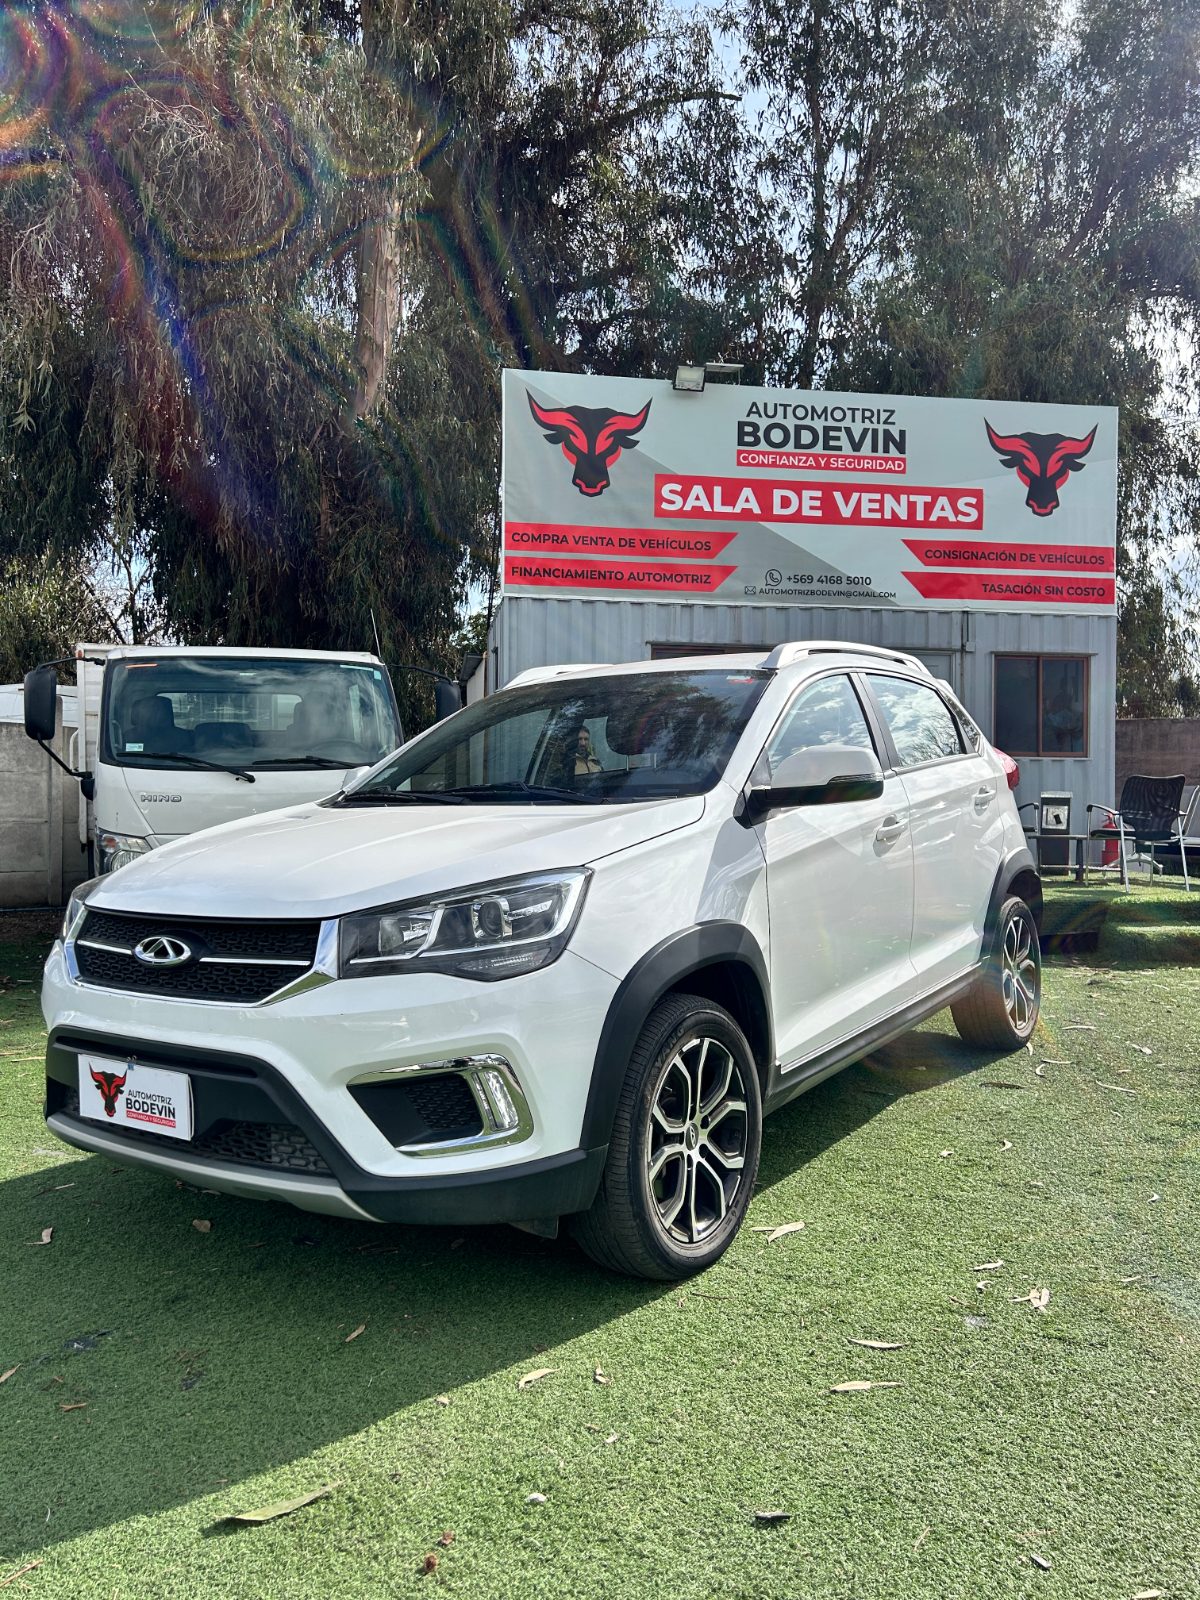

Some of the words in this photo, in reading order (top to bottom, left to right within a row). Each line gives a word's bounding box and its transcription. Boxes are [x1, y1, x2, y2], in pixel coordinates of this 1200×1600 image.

[746, 401, 896, 425] AUTOMOTRIZ
[737, 420, 907, 455] BODEVIN
[739, 453, 816, 467] CONFIANZA
[819, 457, 827, 467] Y
[830, 457, 904, 471] SEGURIDAD
[660, 483, 762, 514] SALA
[772, 488, 823, 517] DE
[832, 491, 979, 523] VENTAS
[511, 532, 569, 545] COMPRA
[572, 535, 615, 547] VENTA
[618, 537, 636, 548] DE
[639, 537, 712, 551] VEHÍCULOS
[924, 549, 1017, 562] CONSIGNACIÓN
[1020, 552, 1036, 562] DE
[1039, 551, 1105, 565] VEHÍCULOS
[511, 566, 624, 581] FINANCIAMIENTO
[627, 572, 712, 584] AUTOMOTRIZ
[786, 574, 814, 584] +569
[817, 575, 843, 586] 4168
[846, 576, 872, 586] 5010
[758, 587, 897, 599] AUTOMOTRIZBODEVIN@GMAIL.COM
[982, 582, 1042, 595] TASACIÓN
[1045, 585, 1064, 596] SIN
[1067, 586, 1106, 597] COSTO
[140, 794, 182, 803] HINO
[128, 1089, 172, 1105] AUTOMOTRIZ
[126, 1097, 175, 1119] BODEVIN
